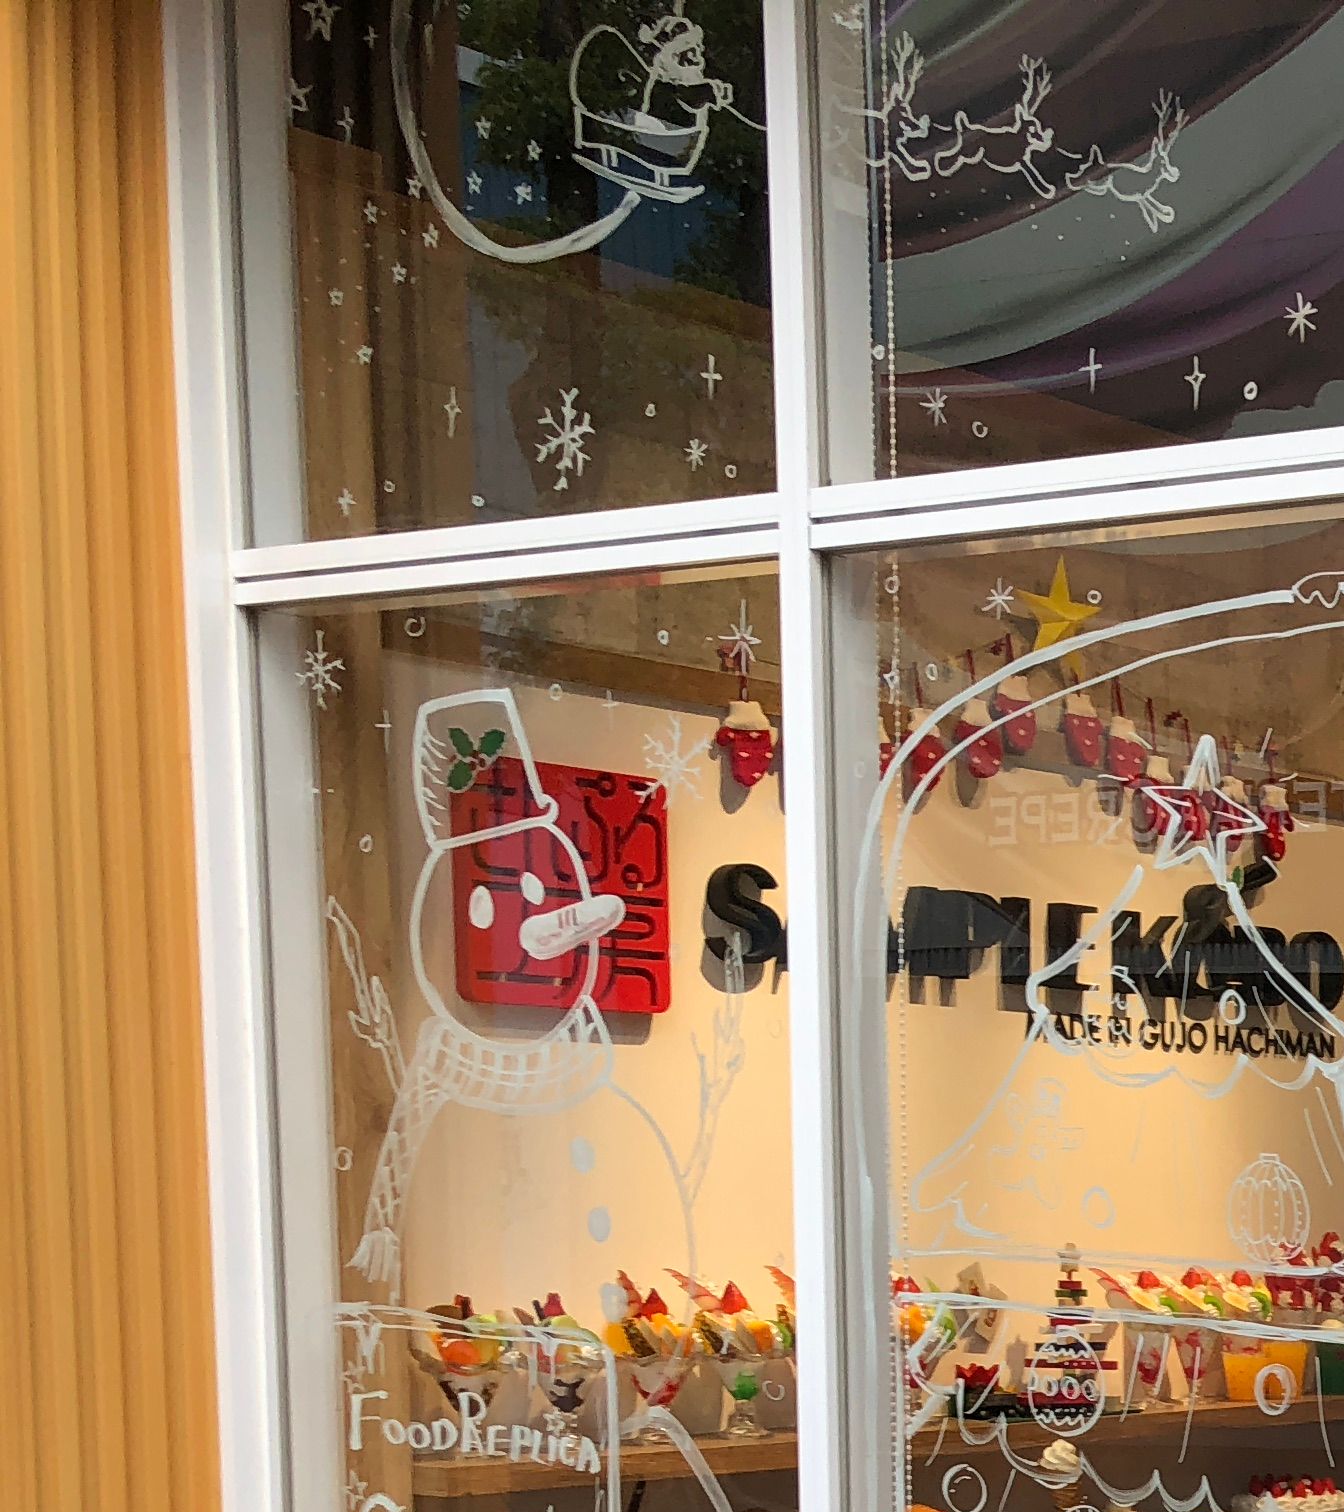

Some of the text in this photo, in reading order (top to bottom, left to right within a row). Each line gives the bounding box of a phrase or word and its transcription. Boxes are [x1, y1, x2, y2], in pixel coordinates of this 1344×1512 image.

[1026, 1012, 1104, 1046] MADE
[1141, 1018, 1207, 1055] GUJO
[1216, 1020, 1336, 1060] HACHIMAN
